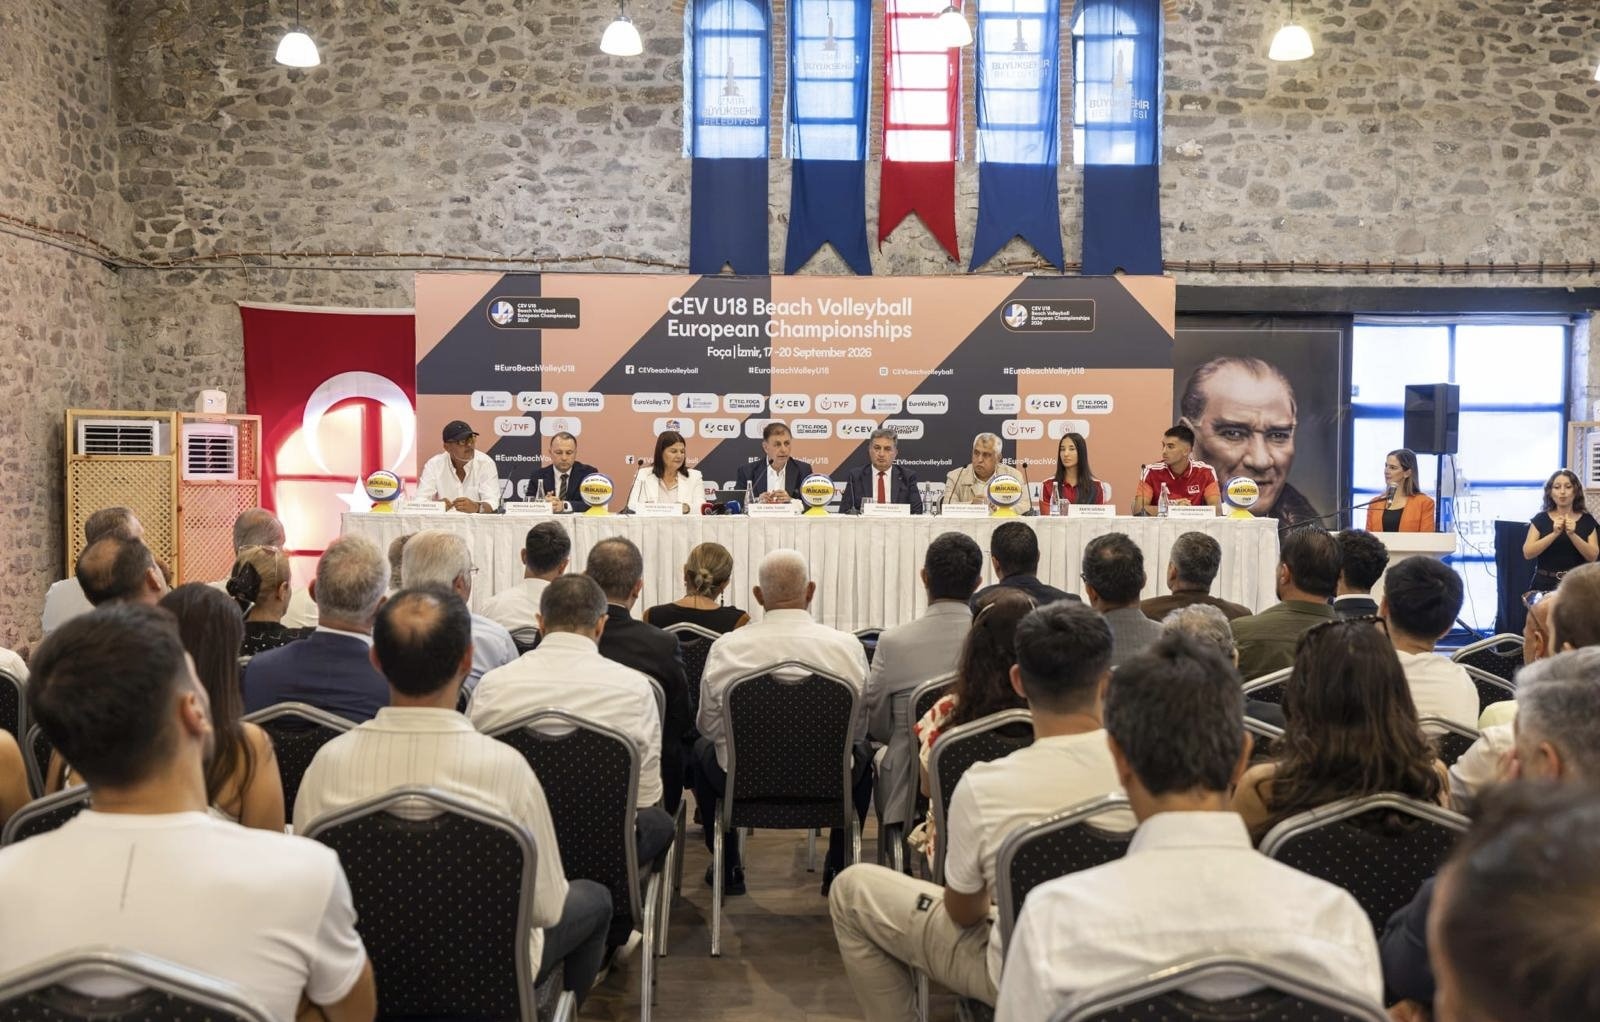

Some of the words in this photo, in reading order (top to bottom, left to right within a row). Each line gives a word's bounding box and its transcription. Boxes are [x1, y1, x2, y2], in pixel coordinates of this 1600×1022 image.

[667, 297, 708, 315] CEV
[713, 297, 747, 315] U18
[753, 297, 812, 315] Beach
[817, 297, 912, 320] Volleyball
[668, 319, 759, 341] European
[764, 319, 912, 342] Championships
[707, 346, 732, 360] Foça
[792, 347, 846, 360] September
[847, 347, 872, 358] 2026
[494, 364, 576, 373] #EuroBeachVolleyU18
[748, 366, 829, 375] #EuroBeachVolleyU18
[1003, 367, 1085, 376] #EuroBeachVolleyU18
[495, 454, 551, 462] #EuroBeachVo
[1001, 457, 1057, 465] #EuroBeachVo
